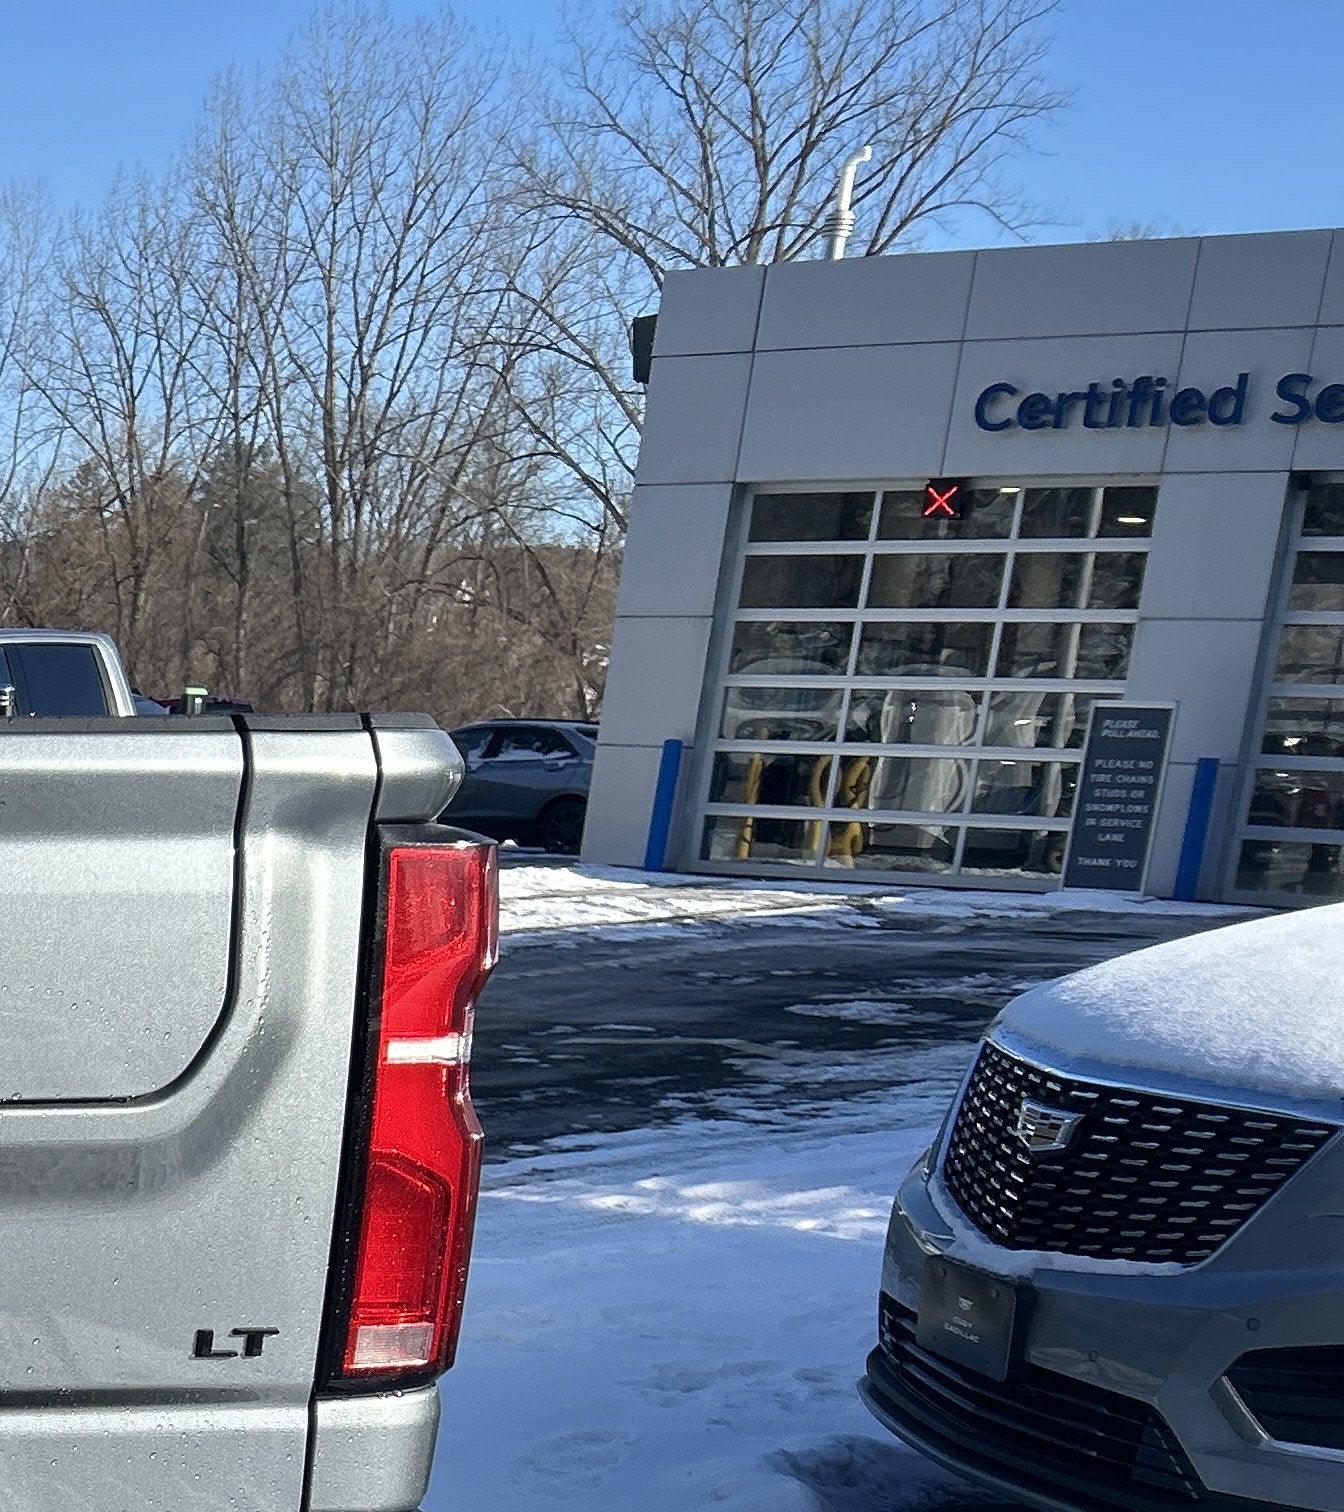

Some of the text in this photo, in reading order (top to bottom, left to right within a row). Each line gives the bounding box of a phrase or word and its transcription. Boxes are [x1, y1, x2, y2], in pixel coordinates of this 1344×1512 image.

[974, 372, 1344, 432] Certified Se
[1095, 759, 1154, 769] PLEASE NO
[1090, 774, 1154, 785] TIRE CHAINS
[1094, 788, 1145, 799] STUDS OR
[1085, 803, 1149, 814] SNOWPLOWS
[1099, 818, 1144, 829] SERVICE
[1098, 833, 1125, 843] LANE
[1078, 857, 1138, 869] THANK YOU
[193, 1327, 280, 1358] LT
